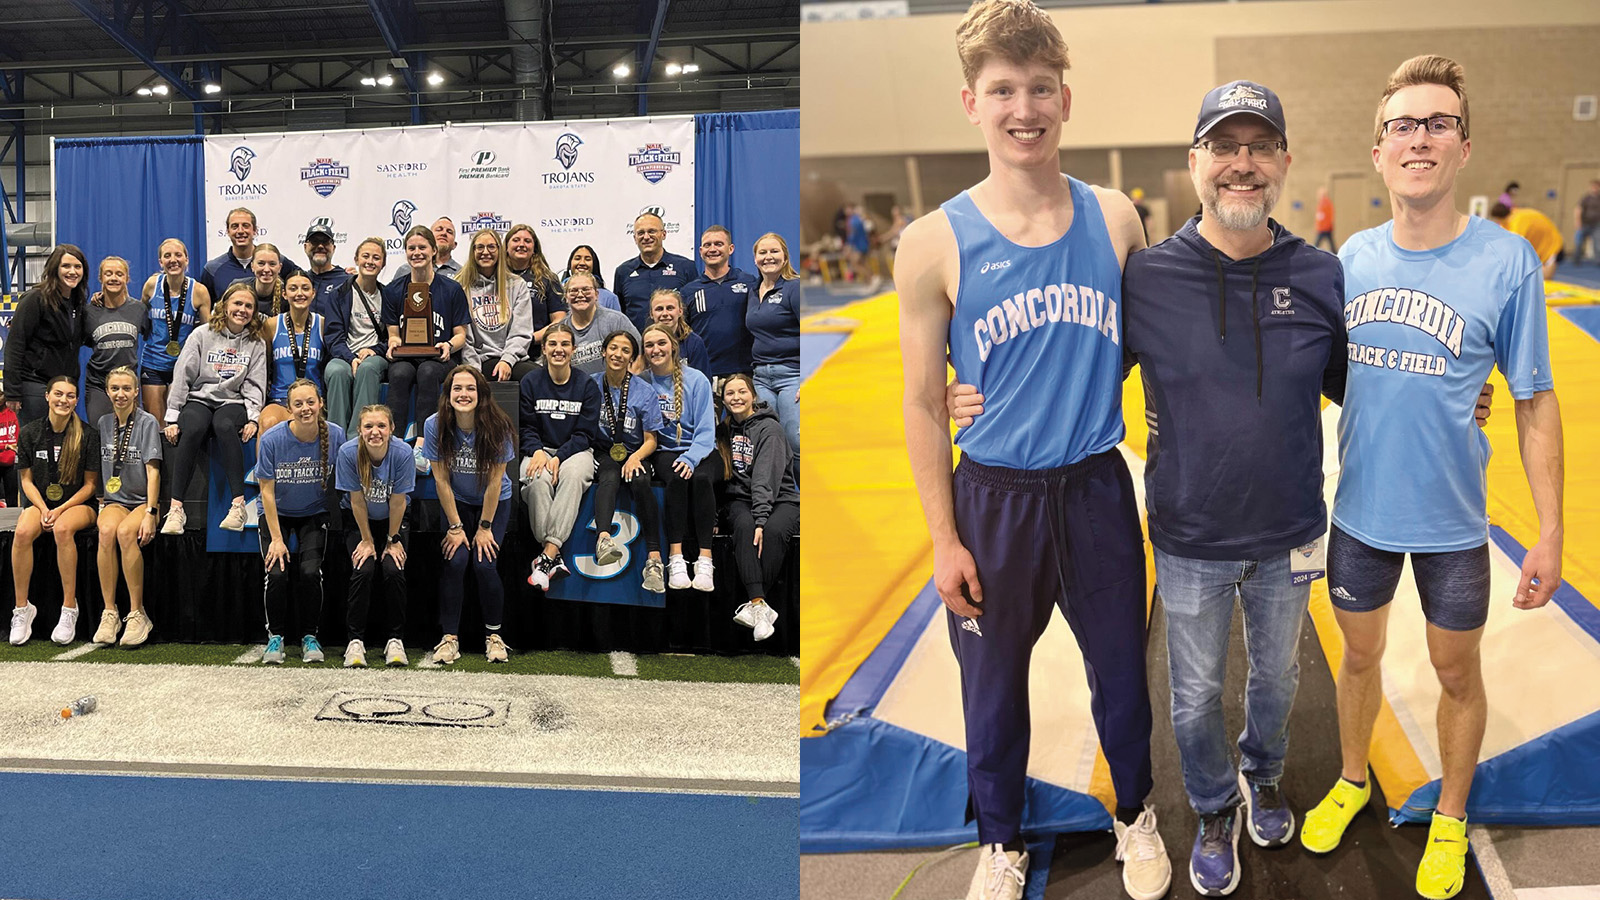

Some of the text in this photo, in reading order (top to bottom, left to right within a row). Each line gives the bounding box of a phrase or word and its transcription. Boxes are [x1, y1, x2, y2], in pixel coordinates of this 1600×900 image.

[630, 154, 654, 165] TRACK
[658, 153, 679, 163] FIELD
[376, 163, 427, 172] SANFORD
[541, 172, 595, 184] TROJANS
[218, 184, 268, 196] TROJANS
[541, 218, 594, 227] SANFORD
[991, 259, 1011, 270] asics
[1271, 287, 1292, 310] C
[974, 283, 1119, 363] CONCORDIA
[1343, 287, 1466, 359] CONCORDIA
[1347, 342, 1387, 368] TRACK
[1398, 350, 1447, 376] FIELD
[534, 399, 582, 413] JUMP CREW
[293, 467, 314, 478] TRACK
[572, 510, 640, 580] 3
[1293, 574, 1308, 584] 2024
